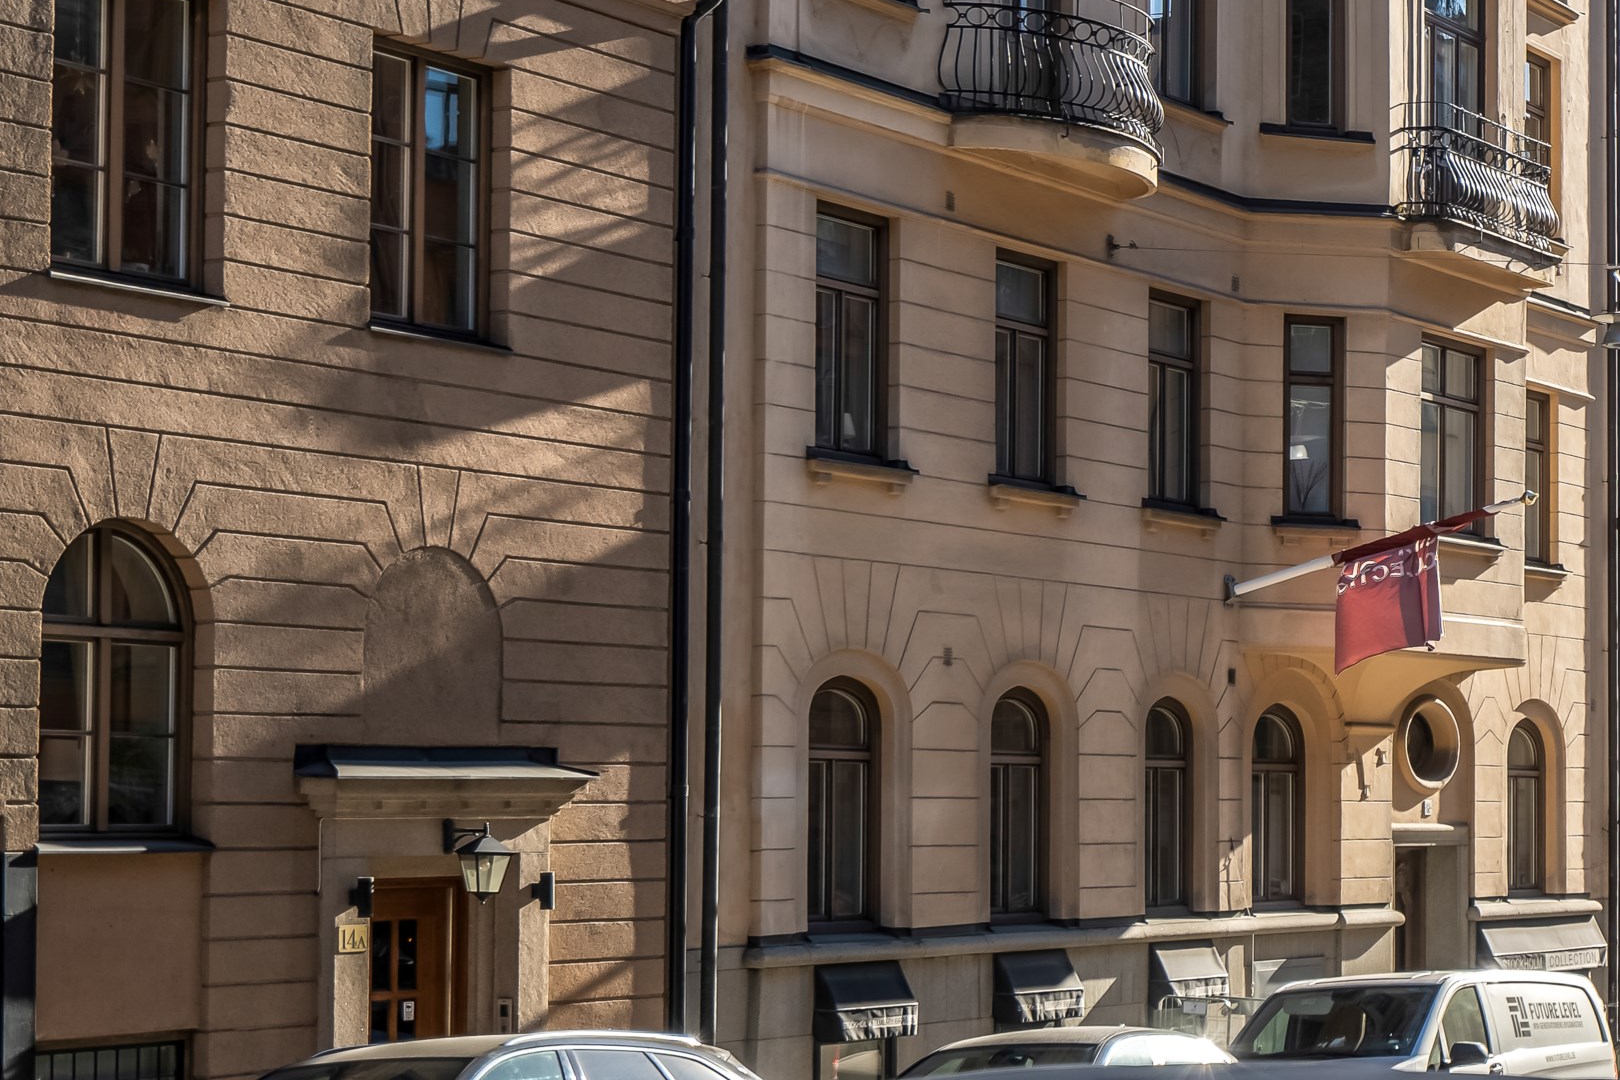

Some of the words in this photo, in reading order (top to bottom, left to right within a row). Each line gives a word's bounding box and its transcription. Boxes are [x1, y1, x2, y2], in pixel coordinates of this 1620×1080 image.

[341, 928, 367, 950] 14A
[1549, 952, 1597, 968] COLLECTION
[1528, 1002, 1560, 1020] FUTURE
[1559, 1002, 1582, 1018] LEVEL
